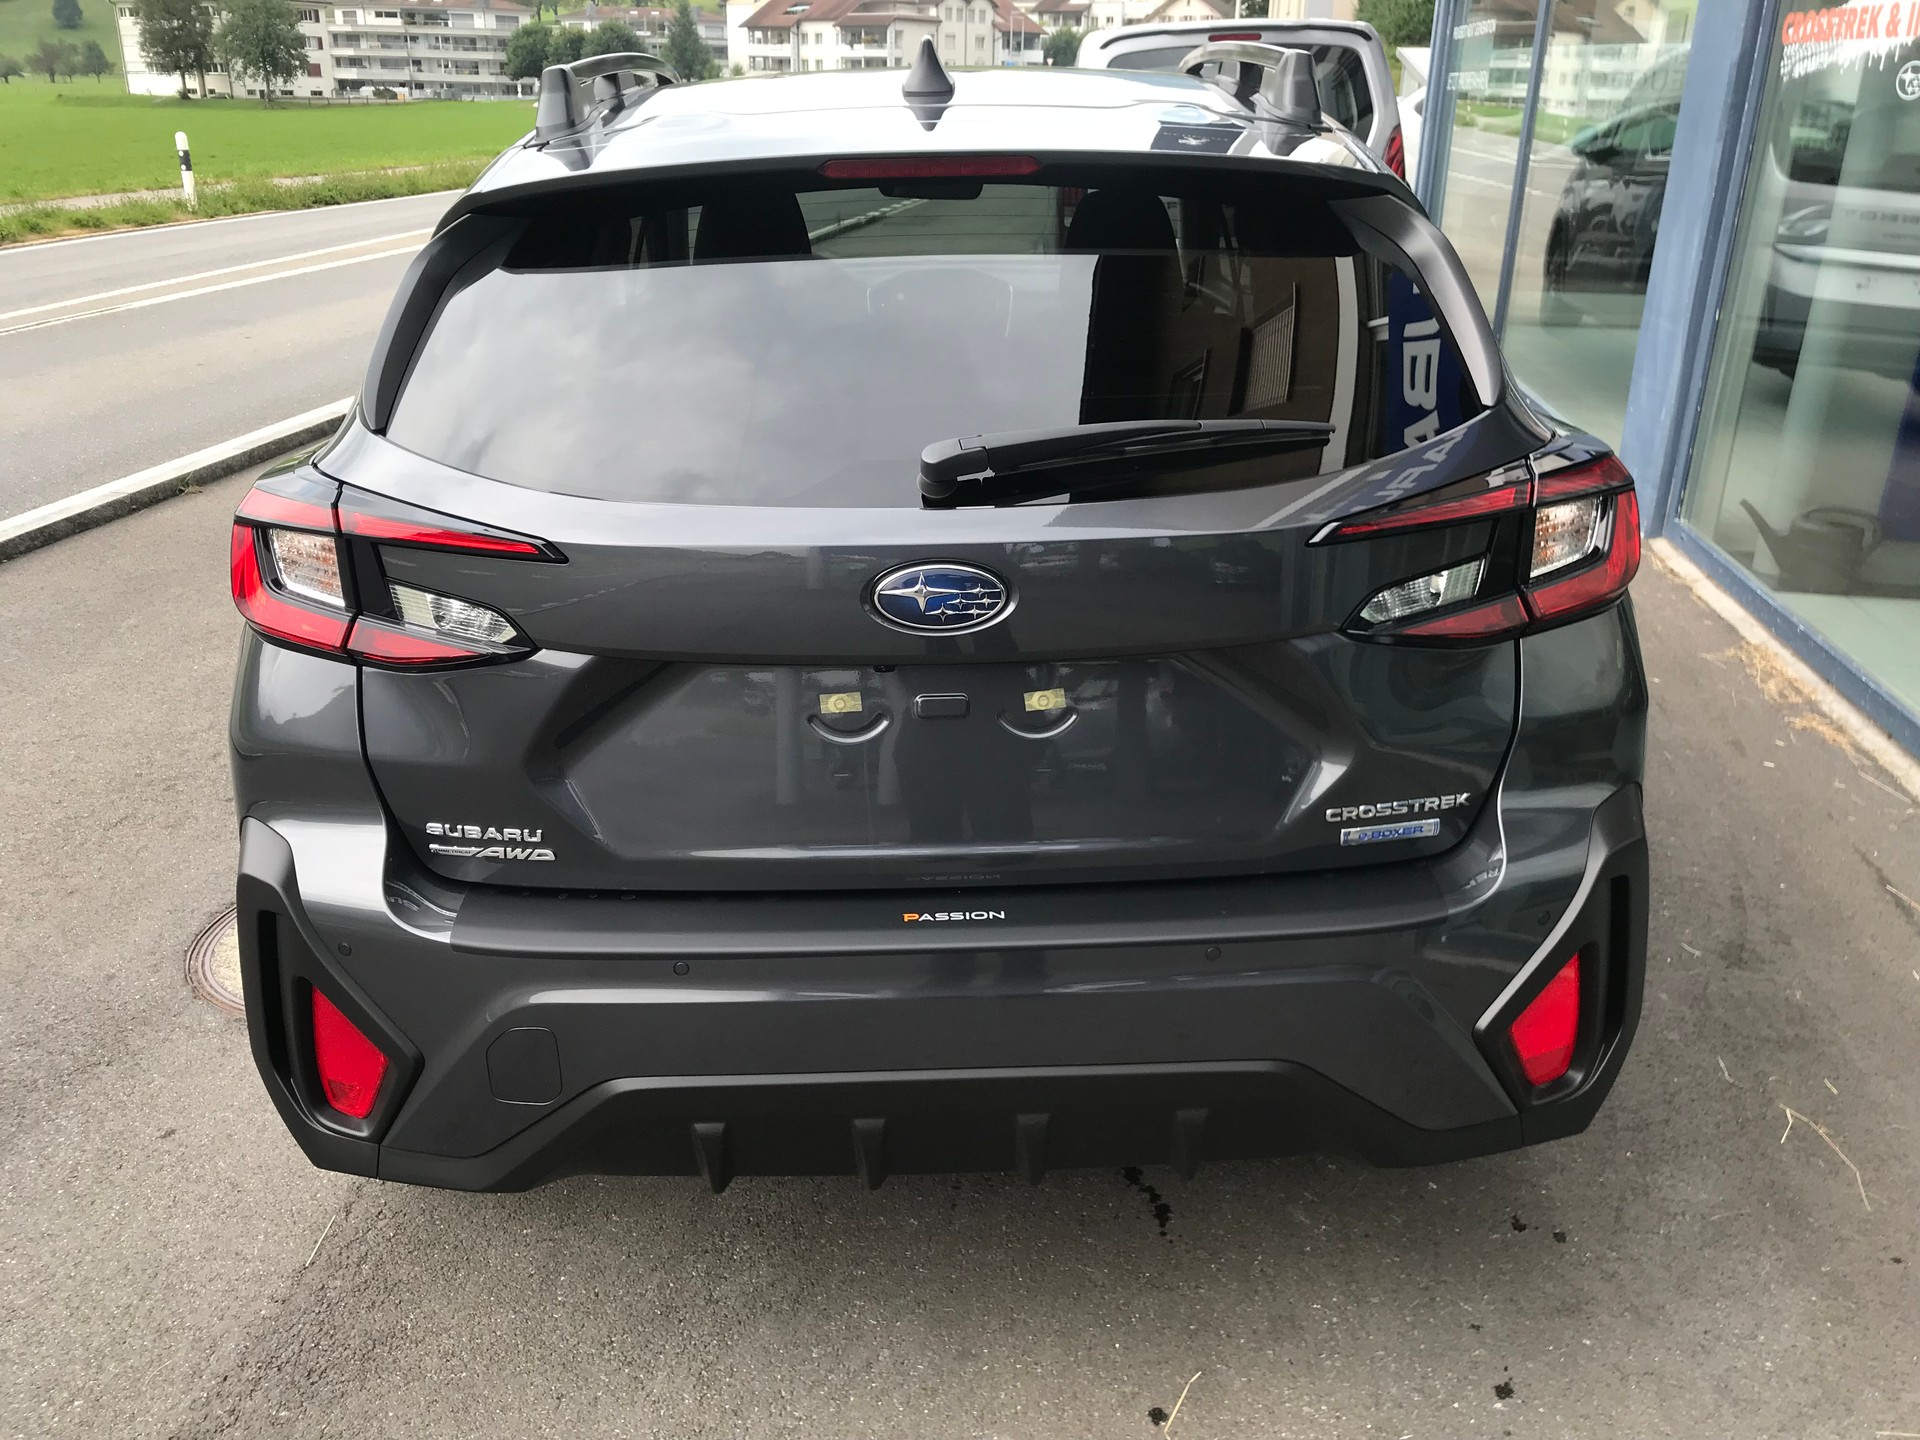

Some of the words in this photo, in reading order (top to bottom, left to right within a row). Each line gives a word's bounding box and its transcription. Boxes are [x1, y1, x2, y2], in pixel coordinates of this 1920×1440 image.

[1782, 4, 1883, 46] CROSSTREK
[1885, 2, 1901, 38] &
[1325, 792, 1471, 823] CROSSTREK
[426, 822, 543, 843] SUBARU
[475, 846, 556, 861] AWD
[902, 911, 1006, 923] PASSION
